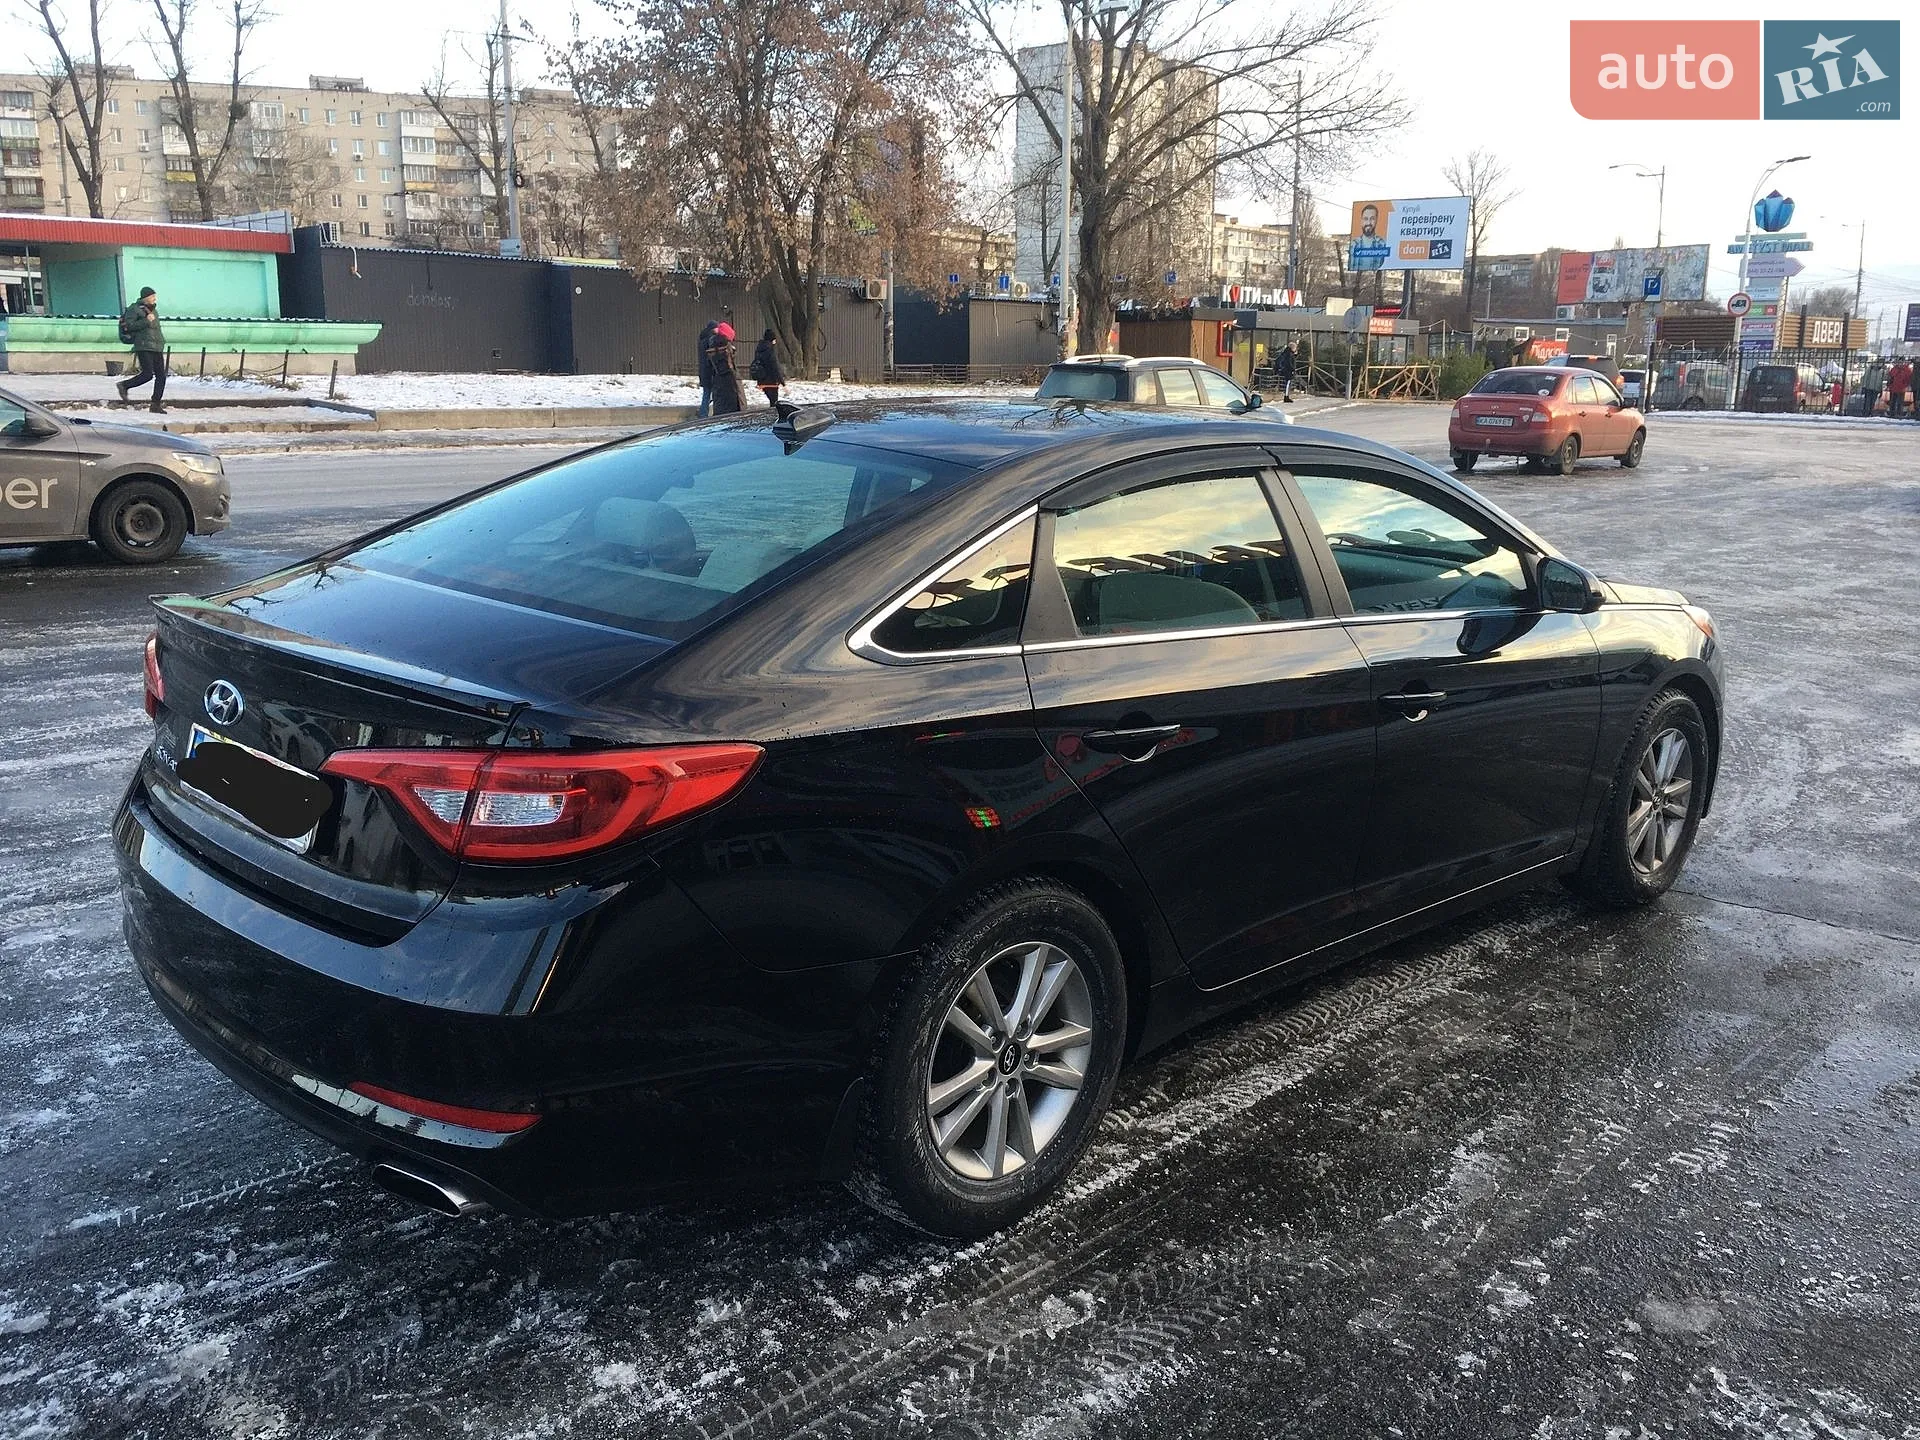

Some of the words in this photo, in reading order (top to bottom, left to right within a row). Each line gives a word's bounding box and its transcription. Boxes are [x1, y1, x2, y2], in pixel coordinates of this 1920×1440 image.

[1401, 213, 1455, 226] перевірену
[1400, 226, 1445, 237] квартиру
[1403, 244, 1425, 255] dom
[0, 477, 58, 509] er
